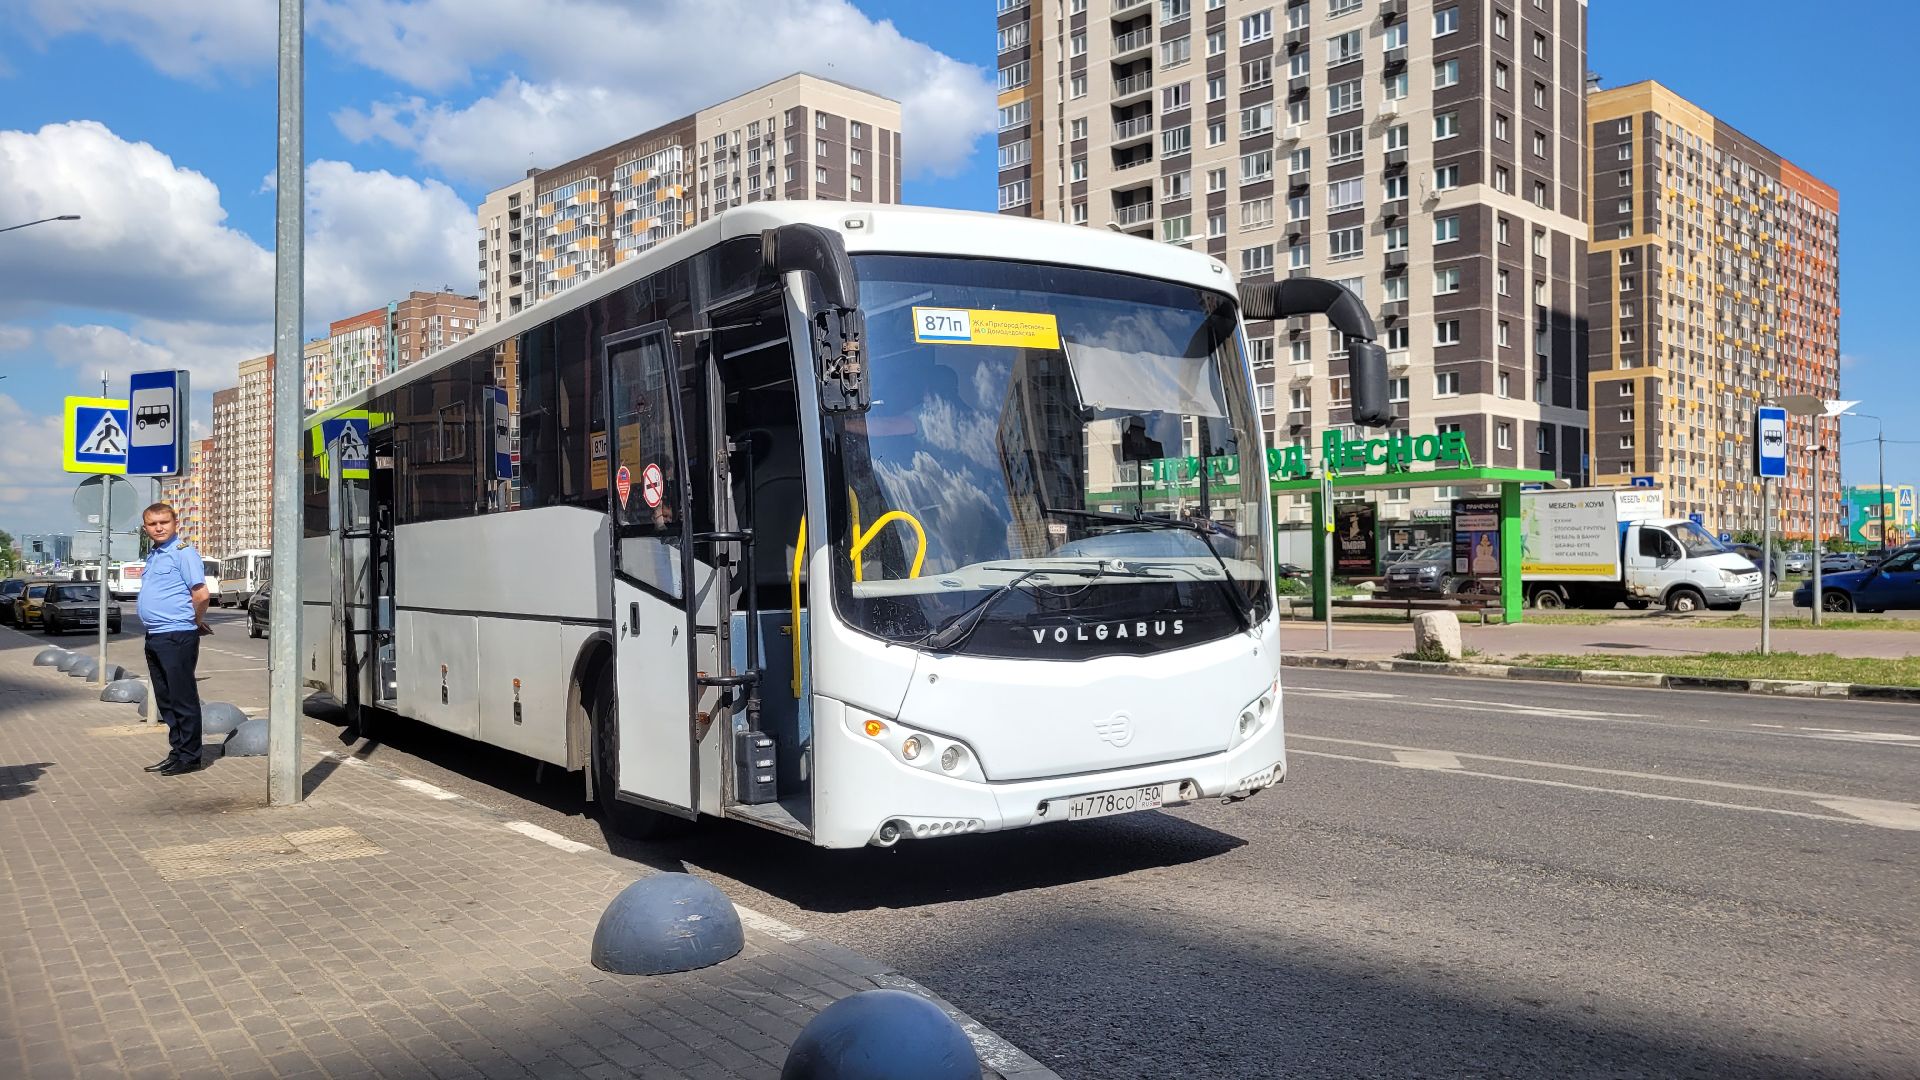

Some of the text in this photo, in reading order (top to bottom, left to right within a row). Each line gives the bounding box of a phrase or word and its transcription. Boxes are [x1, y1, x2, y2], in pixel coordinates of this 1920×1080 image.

[924, 315, 963, 332] 871п
[1322, 429, 1466, 469] ЛЕСНОЕ
[1032, 620, 1184, 644] VOLGABUS
[1074, 787, 1159, 817] Н778СО 750
